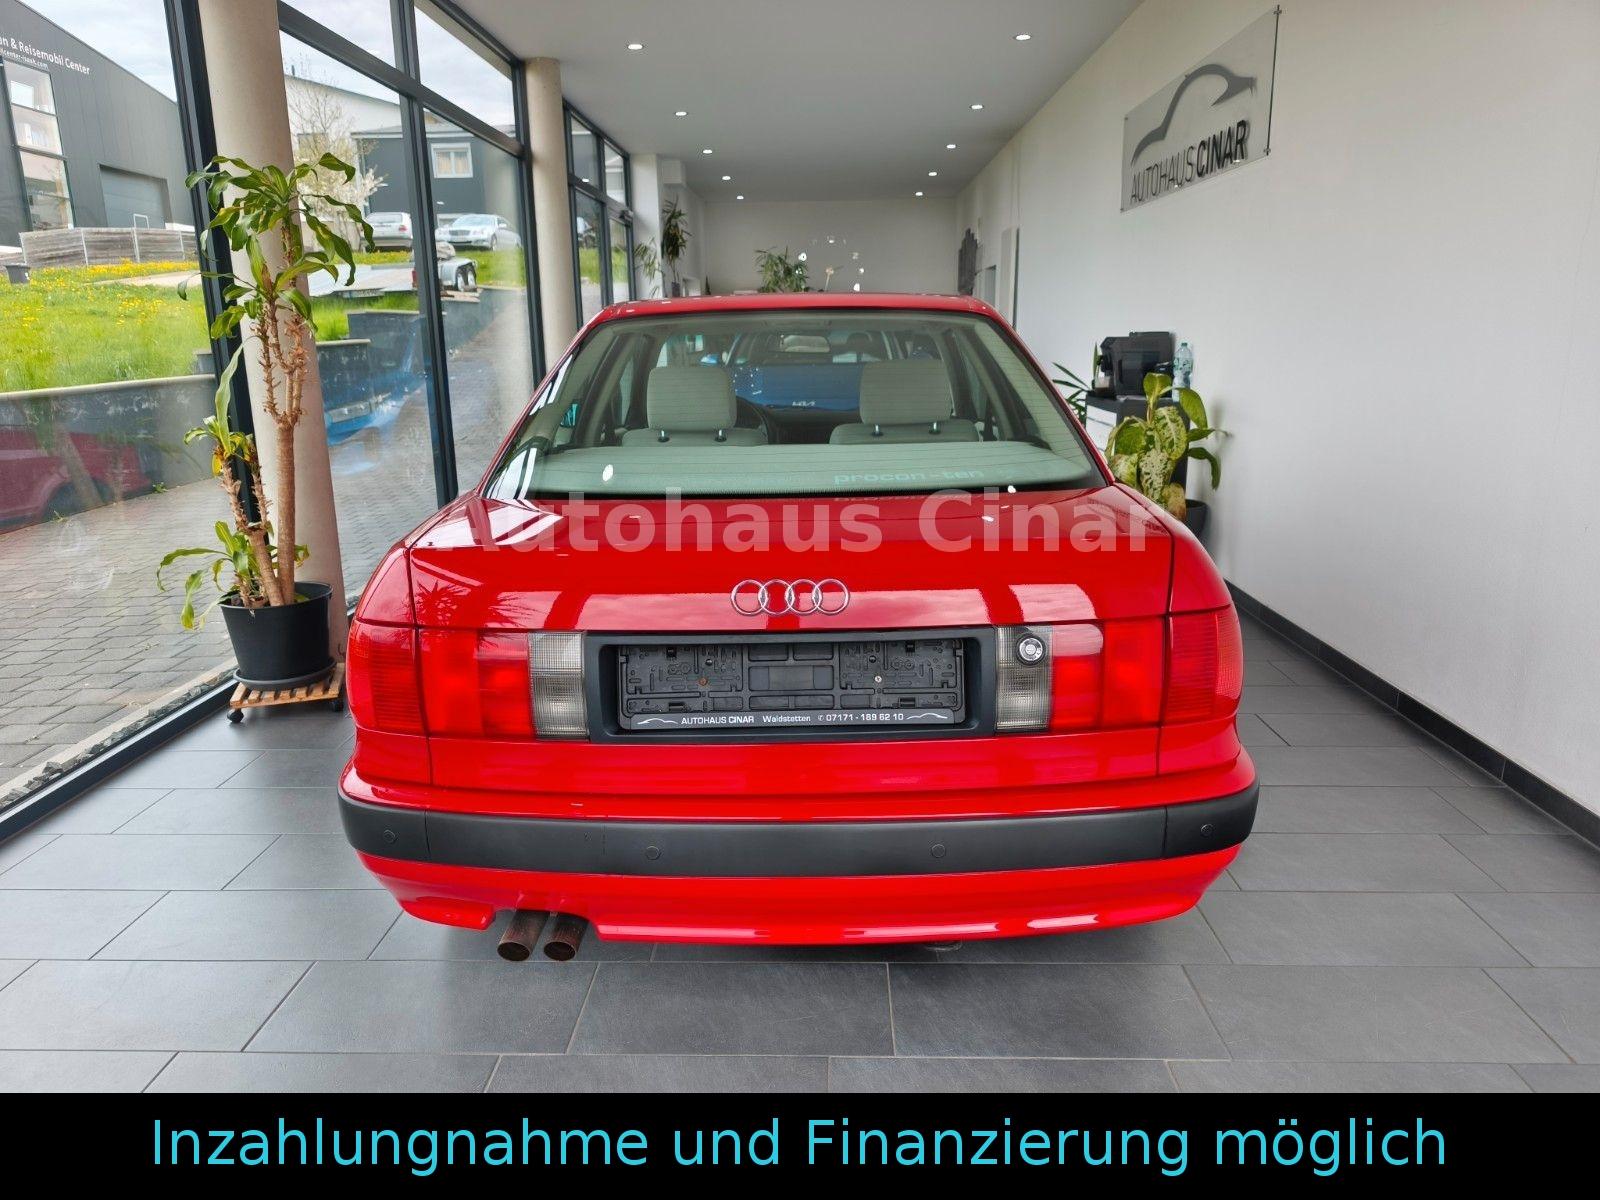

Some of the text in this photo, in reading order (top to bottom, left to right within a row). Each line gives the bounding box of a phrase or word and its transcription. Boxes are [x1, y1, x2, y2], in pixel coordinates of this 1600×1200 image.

[11, 37, 19, 50] &
[19, 41, 64, 66] Reisemobil
[65, 58, 90, 75] Center
[1130, 119, 1249, 206] AUTOHAUS CINAR
[681, 715, 727, 725] AUTOHAUS
[728, 715, 755, 724] CINAR
[762, 714, 811, 724] Waldstetten
[826, 713, 854, 722] 07171
[860, 712, 877, 721] 189
[892, 712, 904, 721] 10
